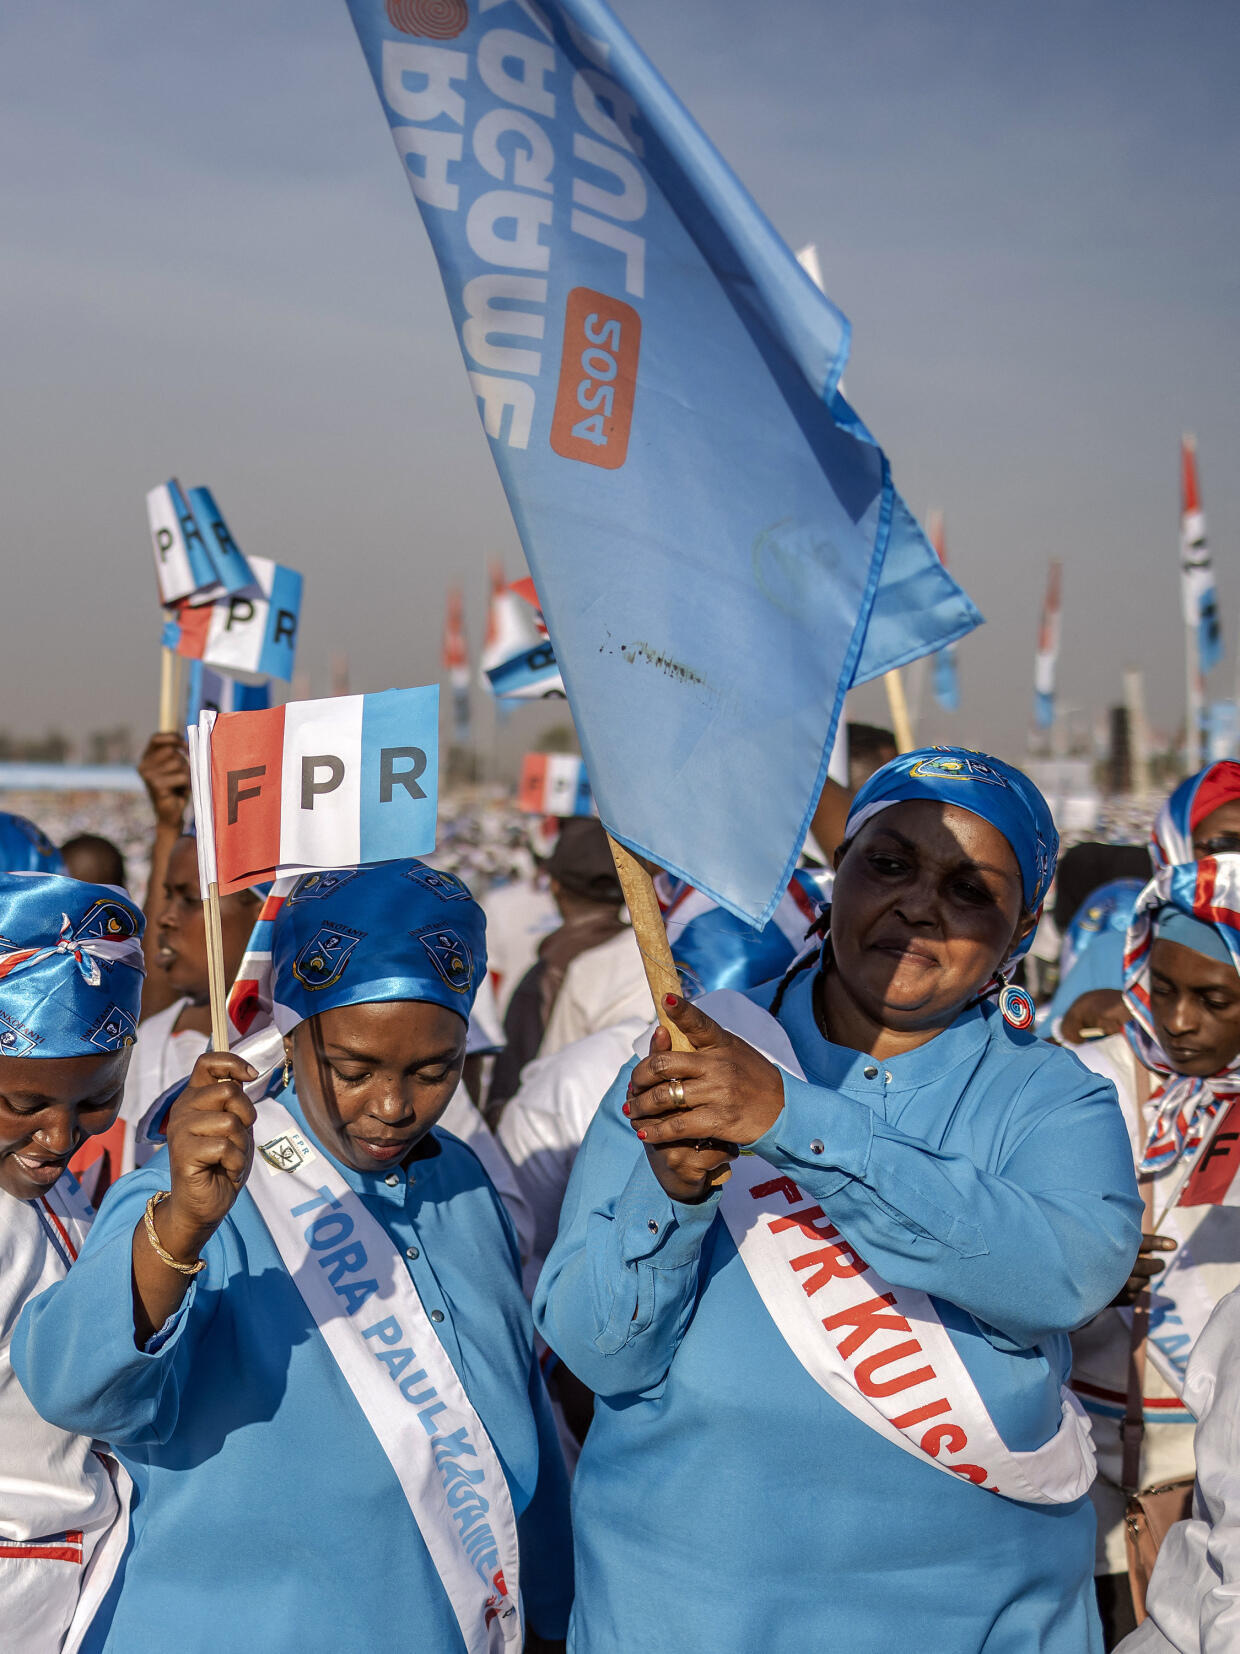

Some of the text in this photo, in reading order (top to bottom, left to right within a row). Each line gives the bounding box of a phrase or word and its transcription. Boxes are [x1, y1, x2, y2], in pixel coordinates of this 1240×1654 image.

[290, 1184, 498, 1589] TORA PAUL KAGAME
